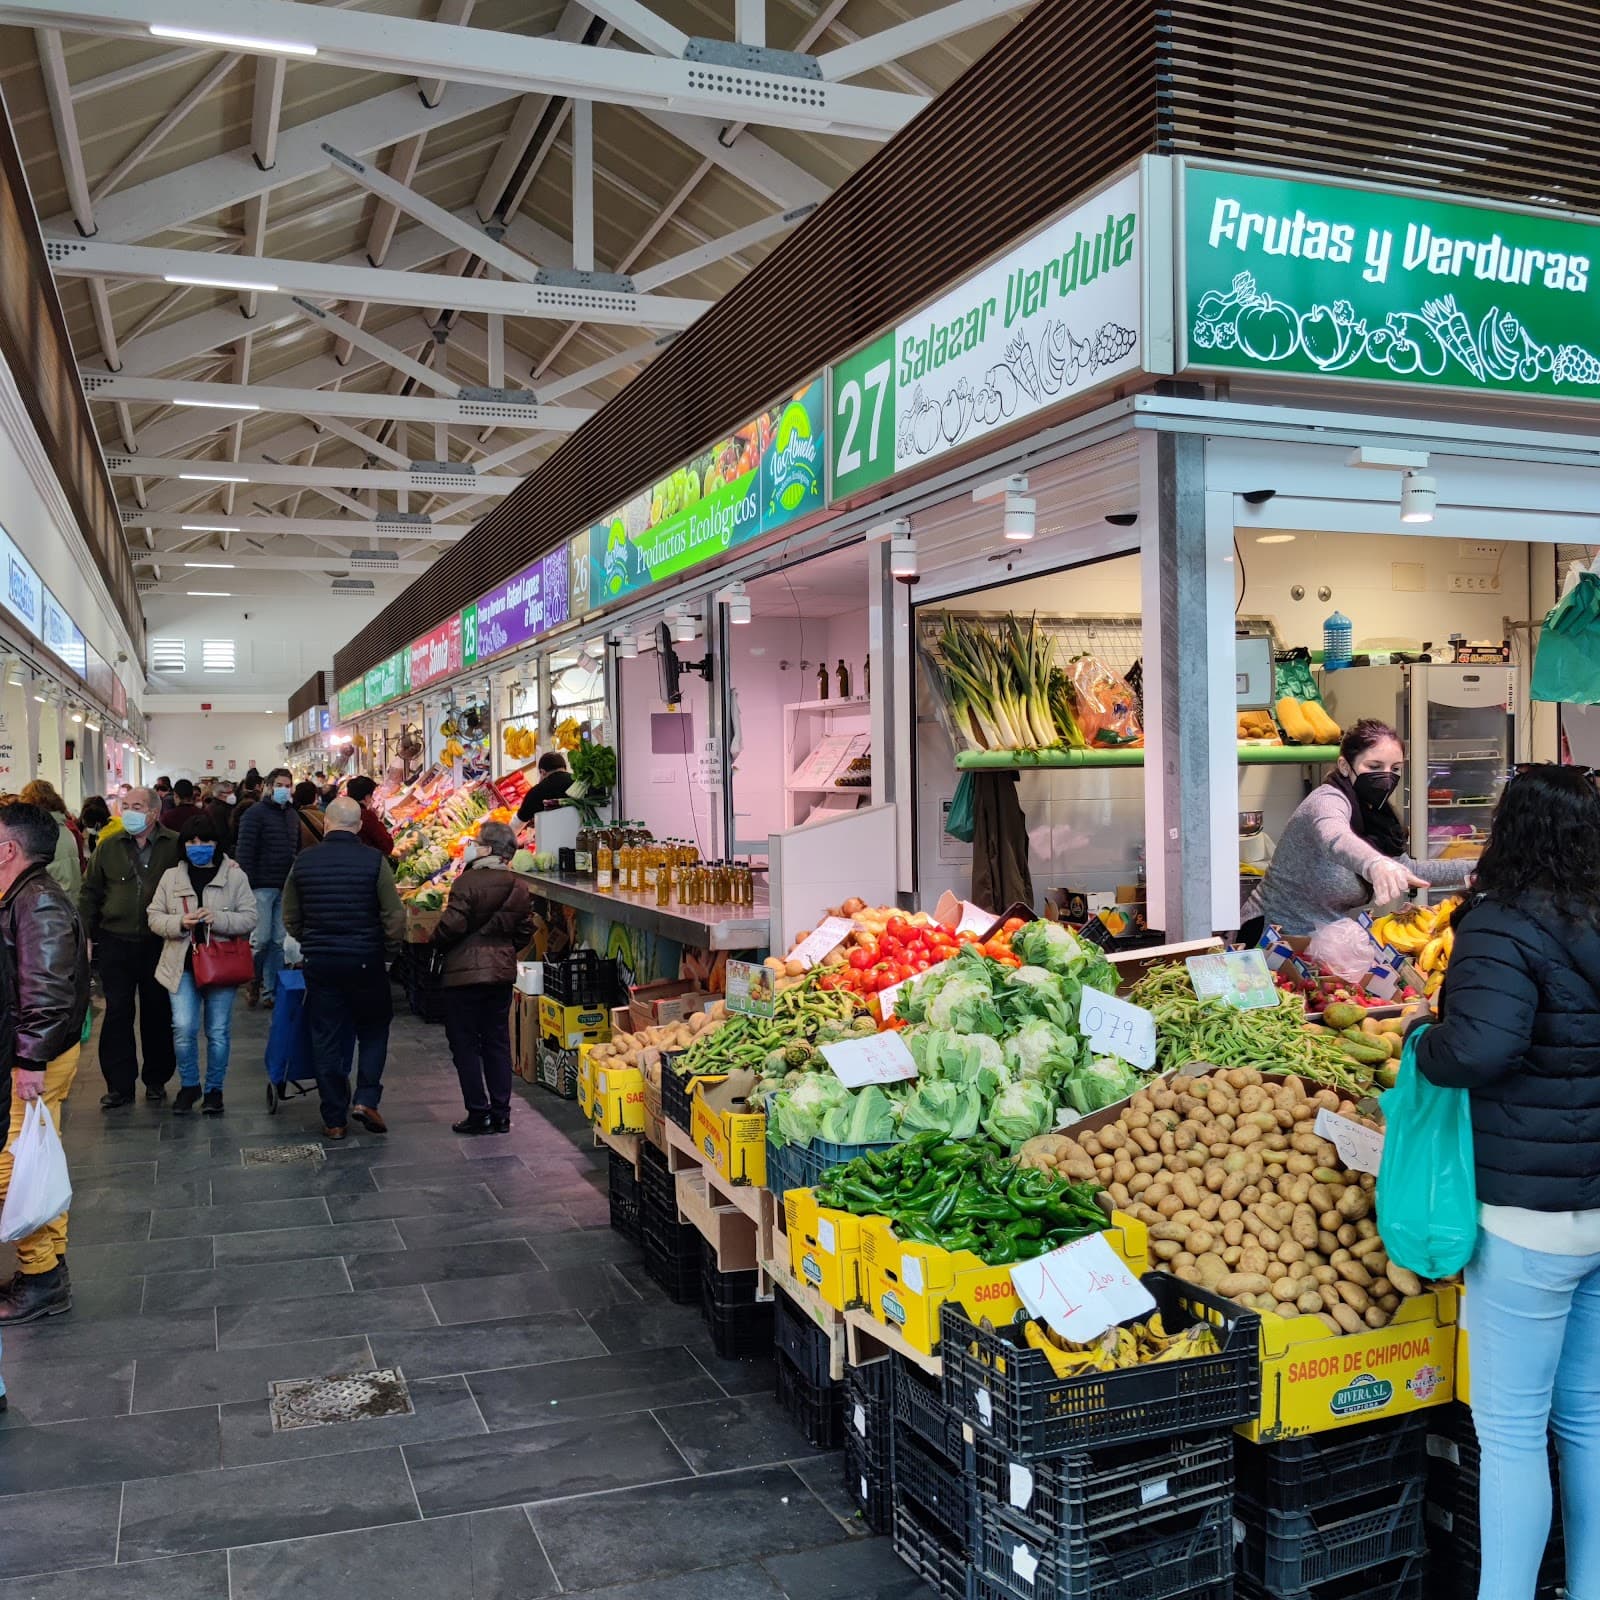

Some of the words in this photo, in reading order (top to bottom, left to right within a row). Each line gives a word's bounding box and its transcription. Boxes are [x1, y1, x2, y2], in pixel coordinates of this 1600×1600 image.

[1208, 197, 1355, 264] Frutas
[1361, 227, 1392, 284] y
[1402, 222, 1590, 293] Verduras
[900, 296, 997, 389] Salazar
[1003, 212, 1136, 329] Verdute
[836, 358, 891, 478] 27
[636, 528, 687, 574] Productos
[689, 491, 757, 548] Ecológicos
[573, 554, 588, 595] 26
[464, 614, 475, 657] 25
[626, 1092, 645, 1104] SAB
[1288, 1356, 1339, 1384] SABOR
[1343, 1351, 1362, 1373] DE
[1366, 1337, 1430, 1369] CHIPIONA
